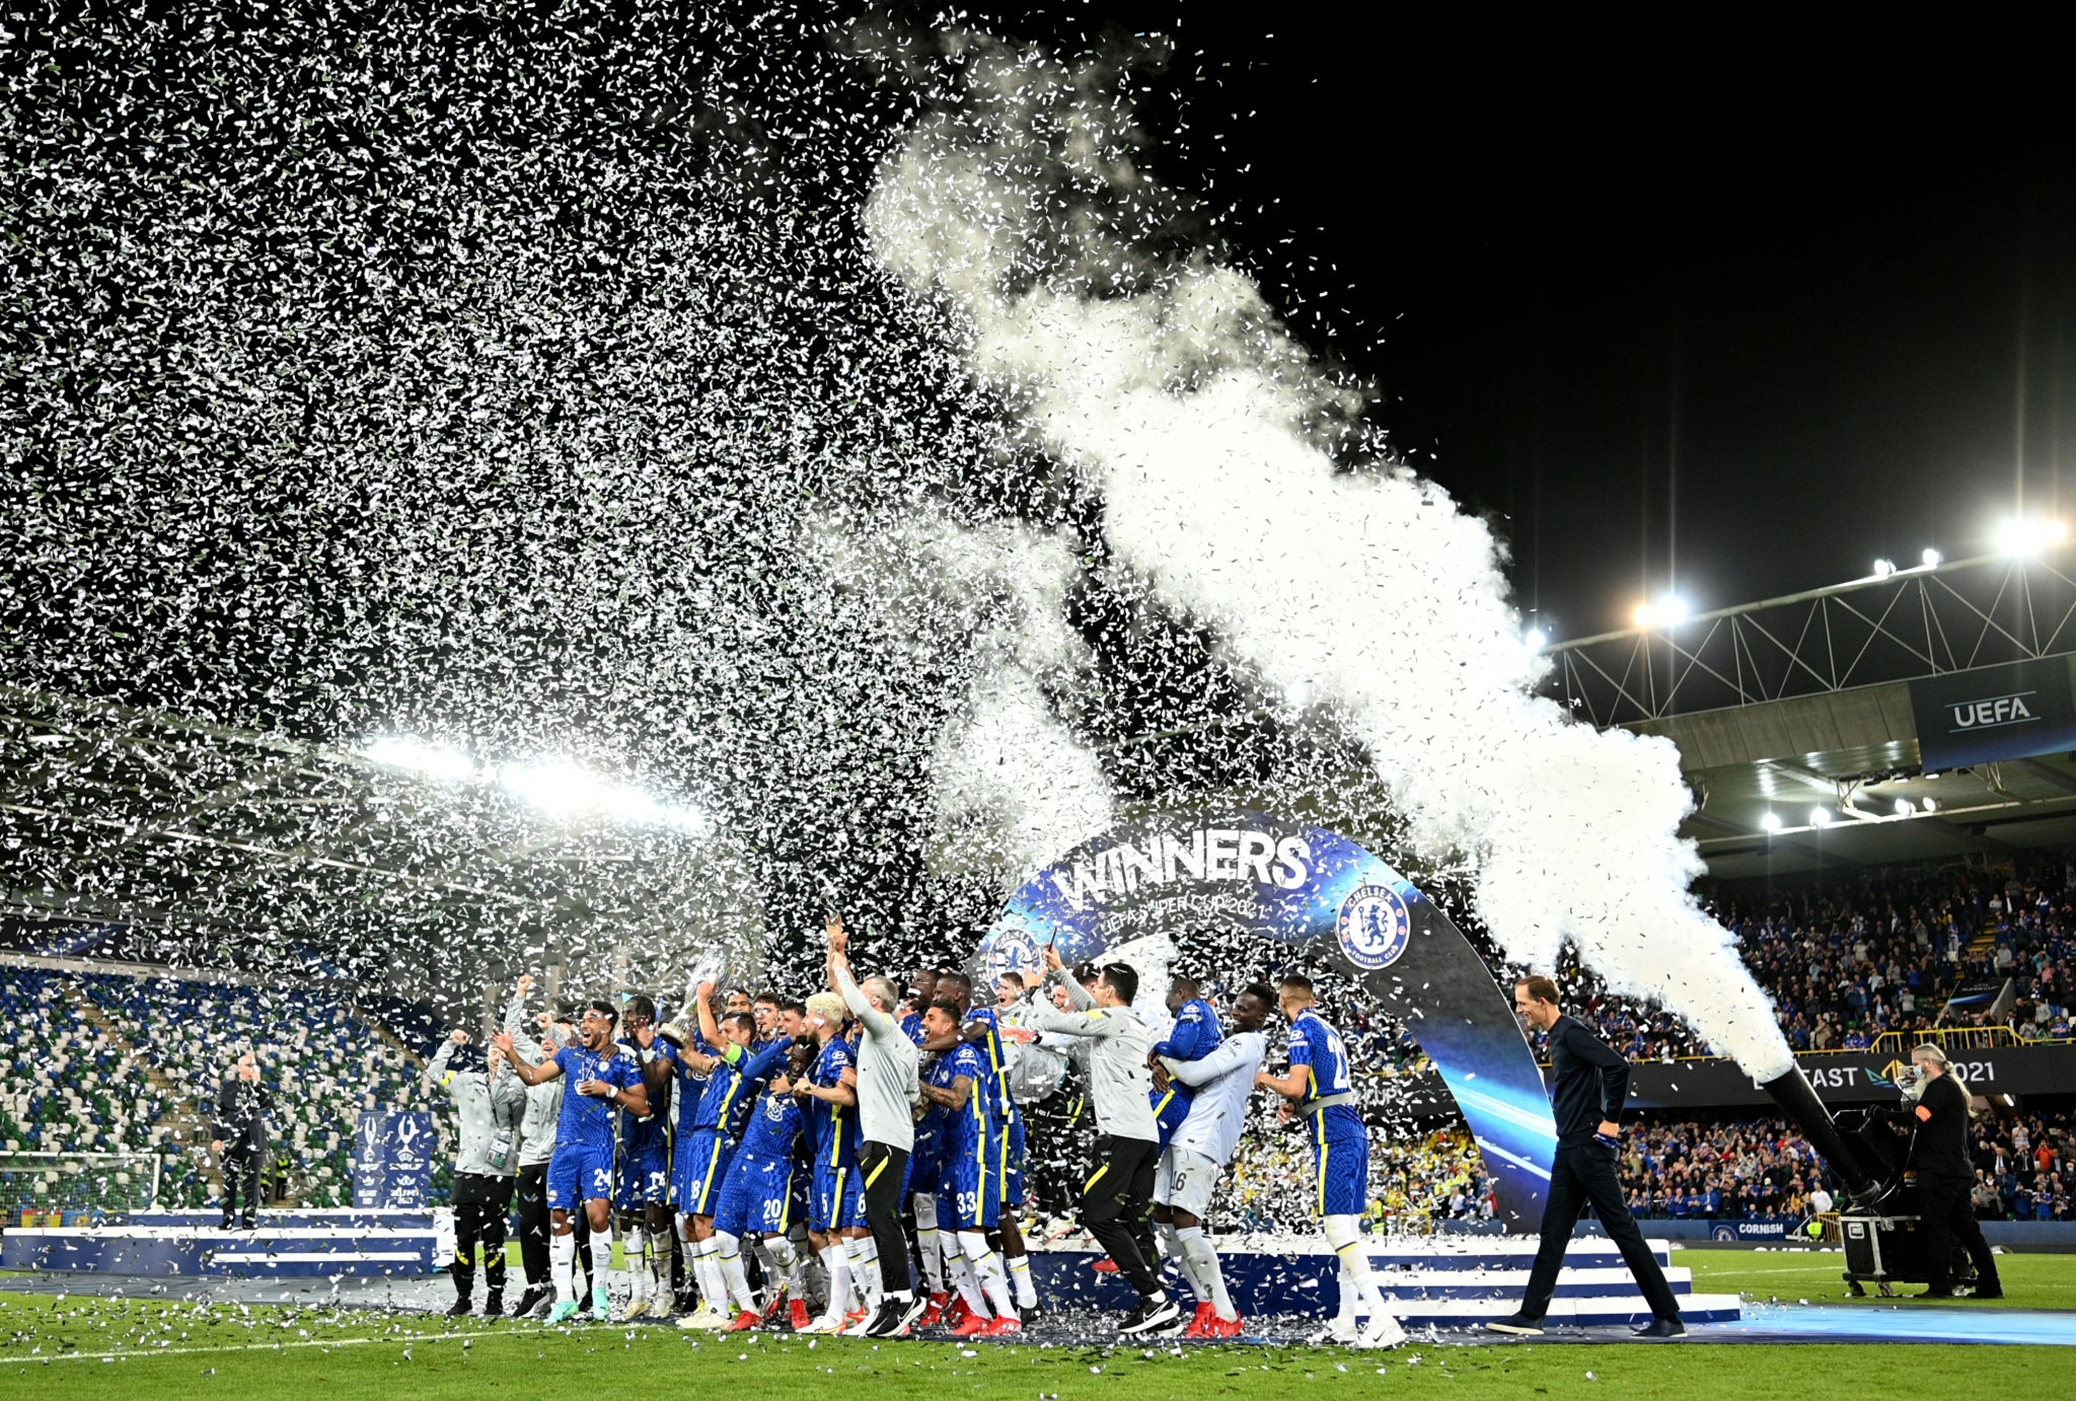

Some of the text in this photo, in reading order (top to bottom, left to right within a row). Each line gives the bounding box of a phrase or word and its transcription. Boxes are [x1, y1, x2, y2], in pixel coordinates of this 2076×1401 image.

[1954, 697, 2031, 727] UEFA
[1051, 829, 1312, 912] WINNERS
[1347, 887, 1393, 907] CHELSEA
[1352, 949, 1383, 963] FOOTBALL
[594, 1168, 612, 1187] 24
[763, 1198, 782, 1219] 20
[957, 1191, 977, 1214] 33
[1739, 1222, 1784, 1234] CORNISH
